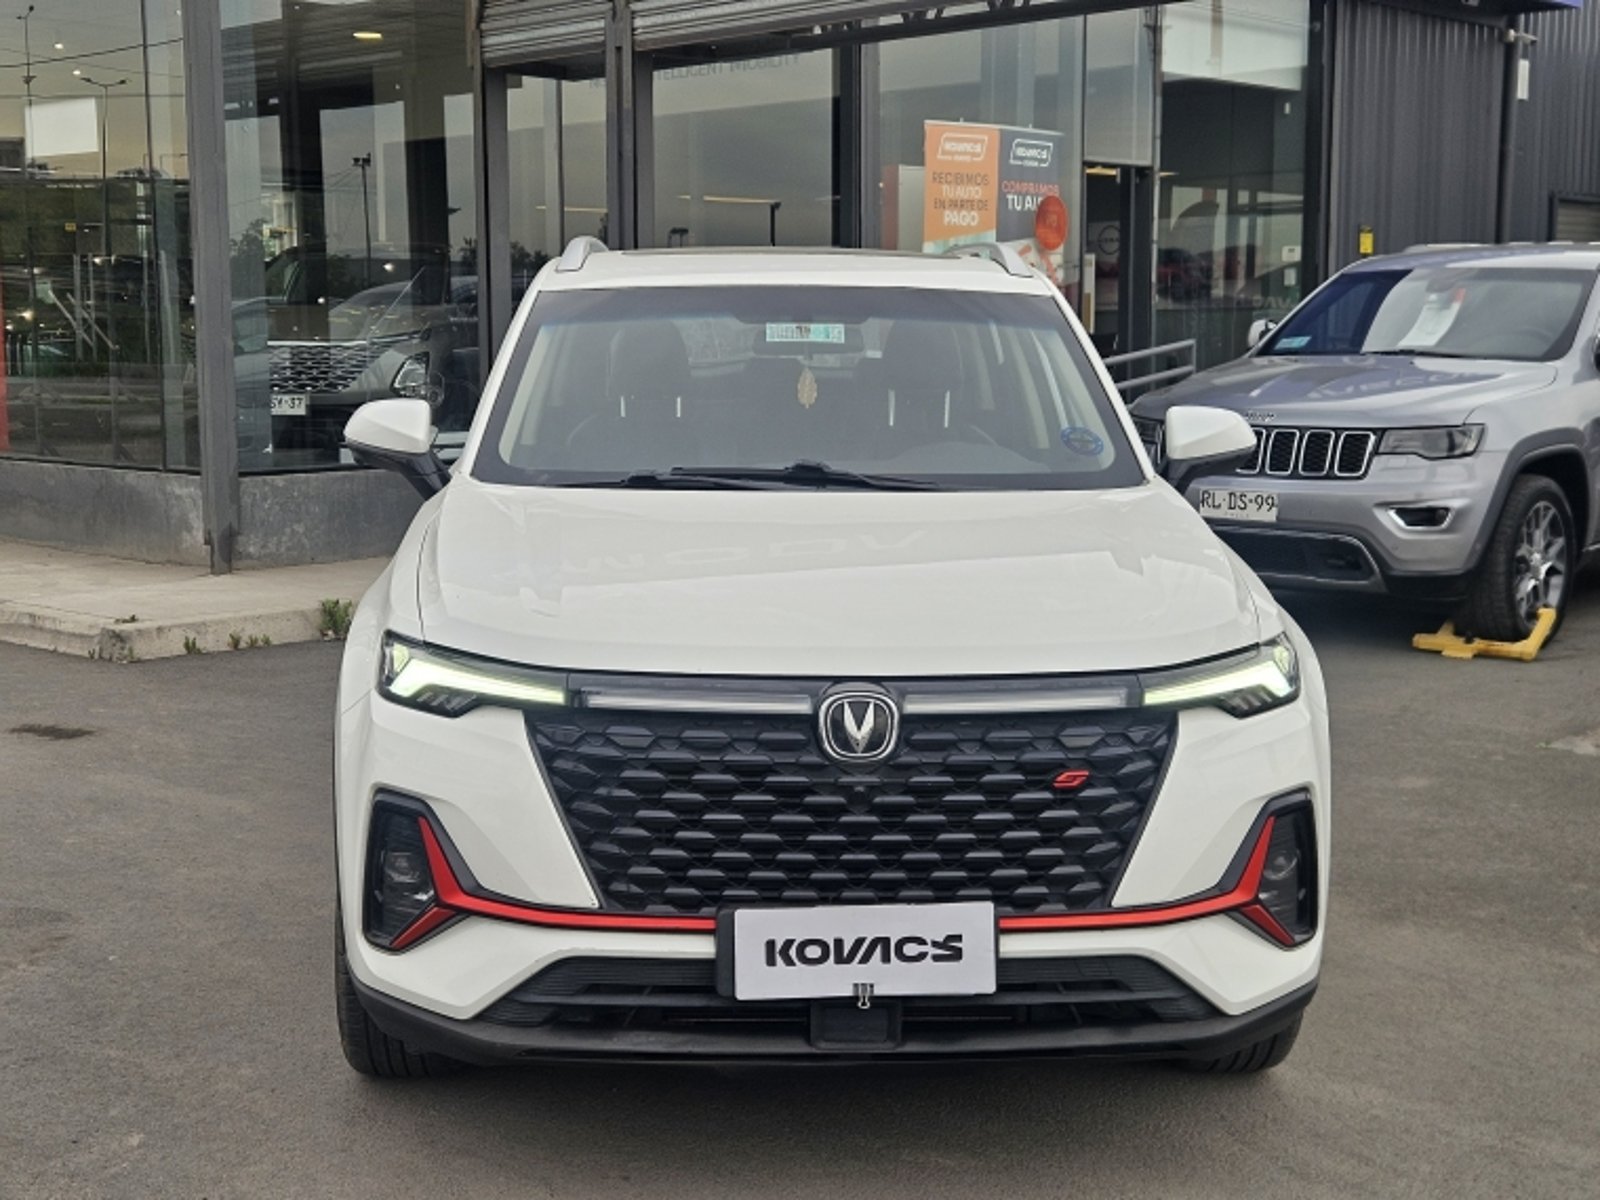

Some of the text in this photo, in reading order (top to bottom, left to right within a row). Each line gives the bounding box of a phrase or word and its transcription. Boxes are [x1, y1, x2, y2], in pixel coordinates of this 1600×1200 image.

[932, 171, 990, 186] RECIBIMOS
[934, 198, 946, 210] EN
[949, 199, 975, 210] PARTE
[1006, 194, 1042, 211] TU AU
[944, 210, 979, 226] PAGO
[765, 934, 963, 967] KOVACS
